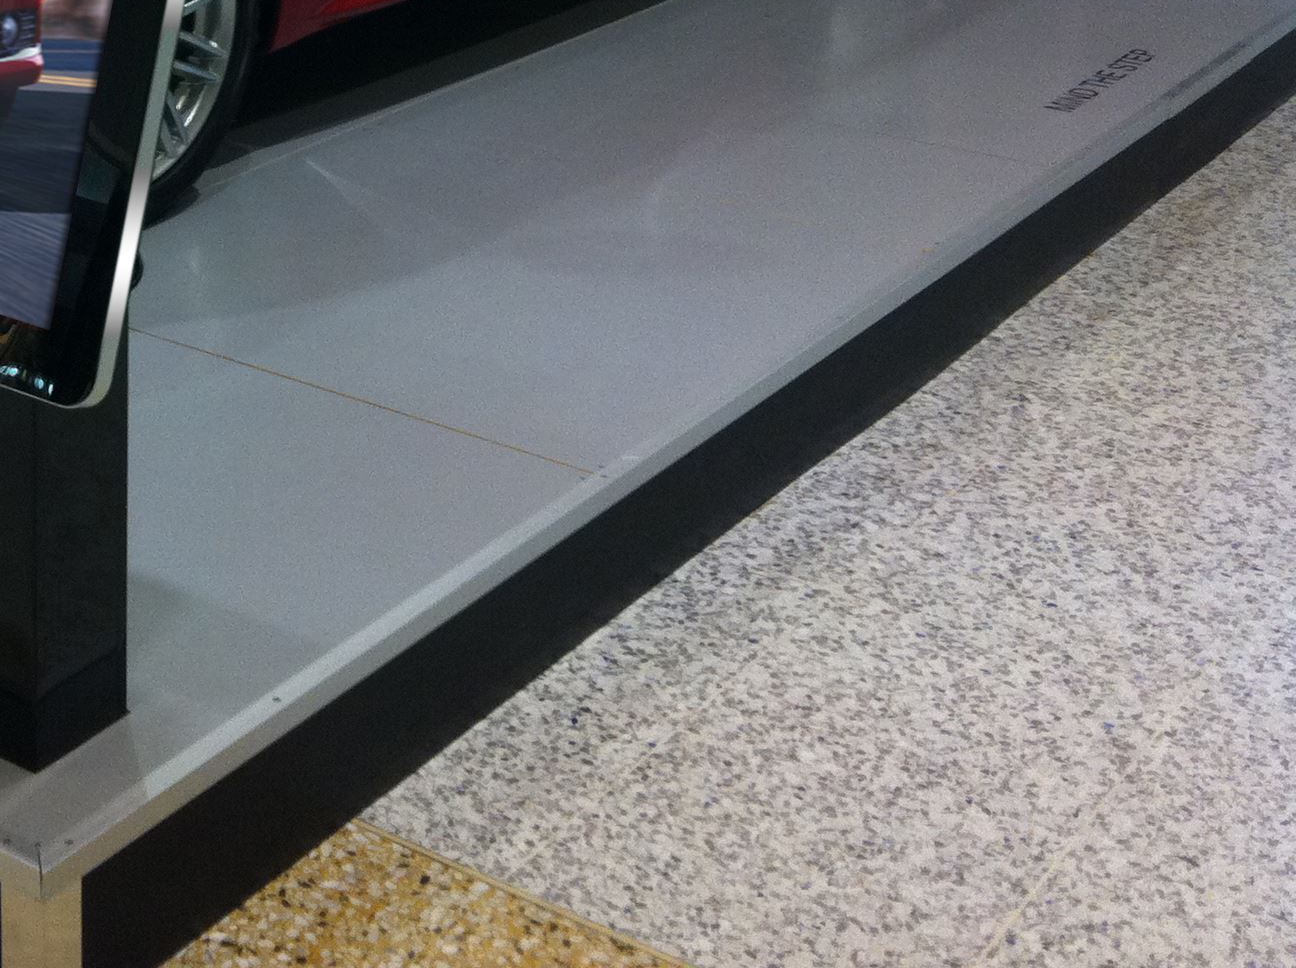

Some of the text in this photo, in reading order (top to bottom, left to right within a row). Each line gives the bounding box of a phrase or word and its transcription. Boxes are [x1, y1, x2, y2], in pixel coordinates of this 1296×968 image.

[1044, 49, 1154, 112] MIND THE STEP
